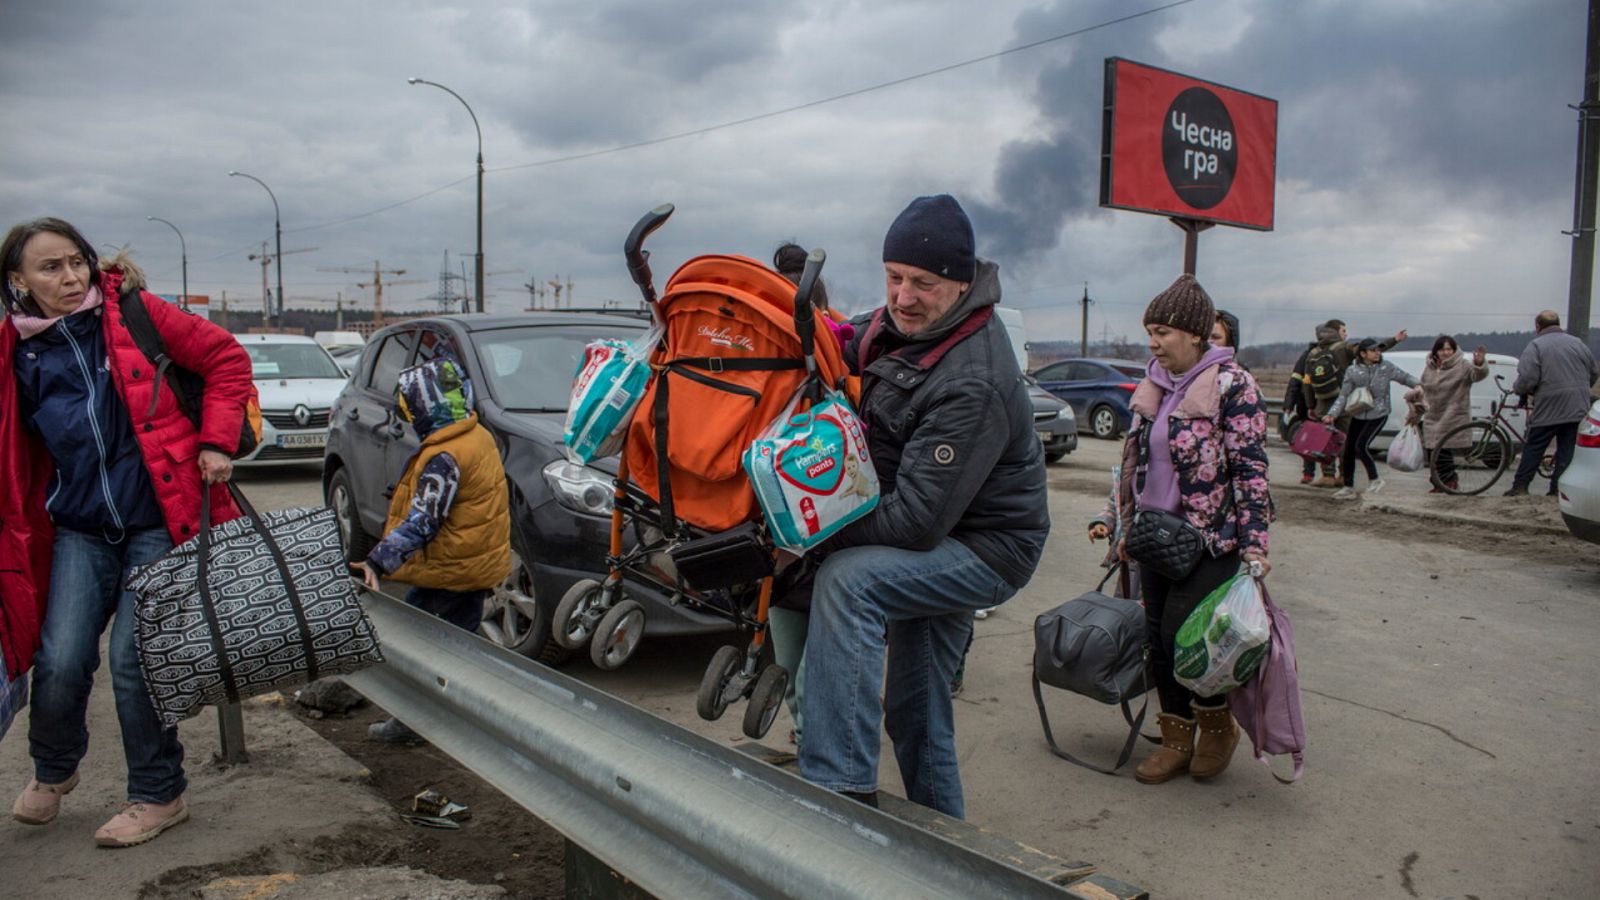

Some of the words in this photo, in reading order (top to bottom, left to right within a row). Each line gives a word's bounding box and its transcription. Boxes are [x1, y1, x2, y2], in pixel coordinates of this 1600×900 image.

[1172, 110, 1232, 151] Чесна
[1184, 149, 1218, 180] гра
[809, 457, 834, 478] pants
[175, 566, 197, 579] CADA
